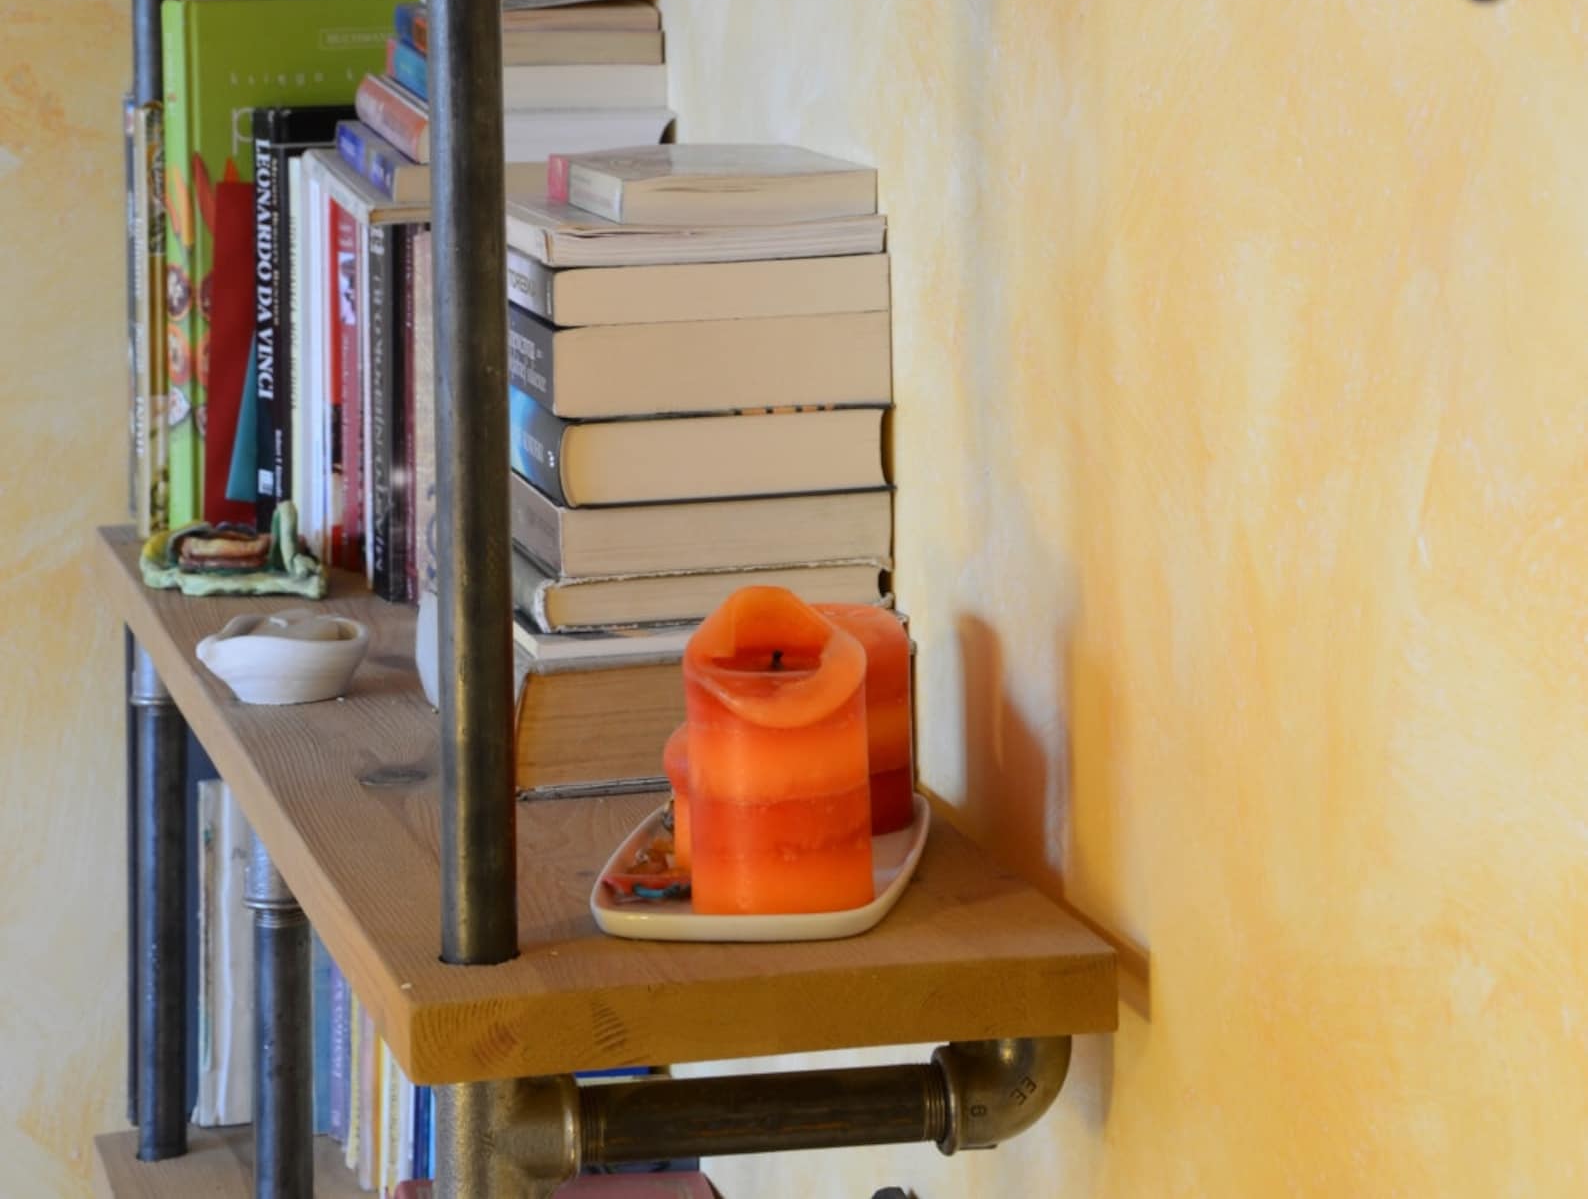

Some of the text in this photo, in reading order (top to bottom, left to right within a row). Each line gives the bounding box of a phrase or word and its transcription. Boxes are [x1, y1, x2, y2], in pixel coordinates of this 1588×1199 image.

[255, 139, 274, 399] LEONARDO DA VINCI
